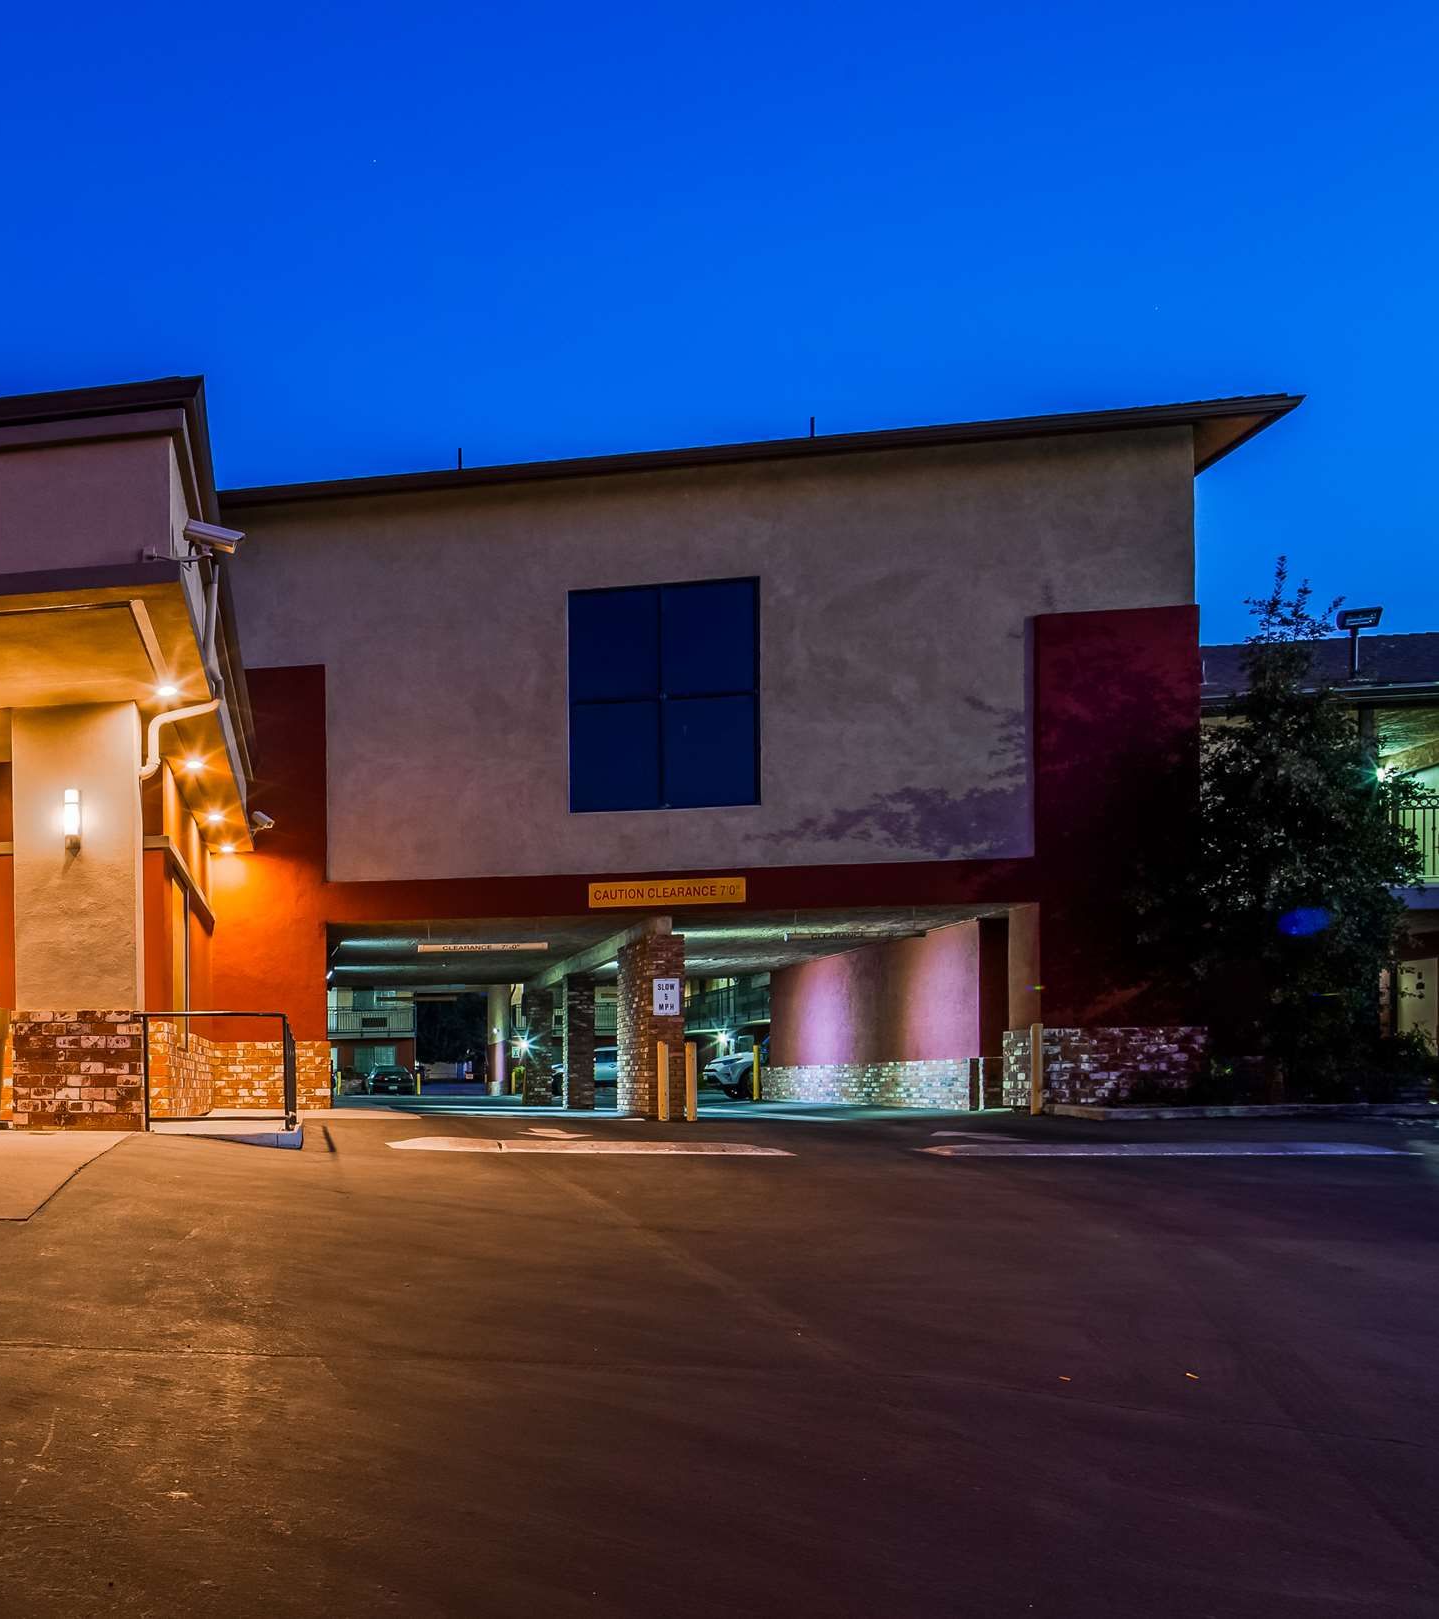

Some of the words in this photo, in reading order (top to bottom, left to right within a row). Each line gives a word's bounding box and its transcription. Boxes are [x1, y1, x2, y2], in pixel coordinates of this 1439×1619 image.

[593, 888, 644, 901] CAUTION
[647, 885, 717, 899] CLEARANCE
[657, 983, 676, 991] SLOW
[658, 1003, 675, 1011] MPH
